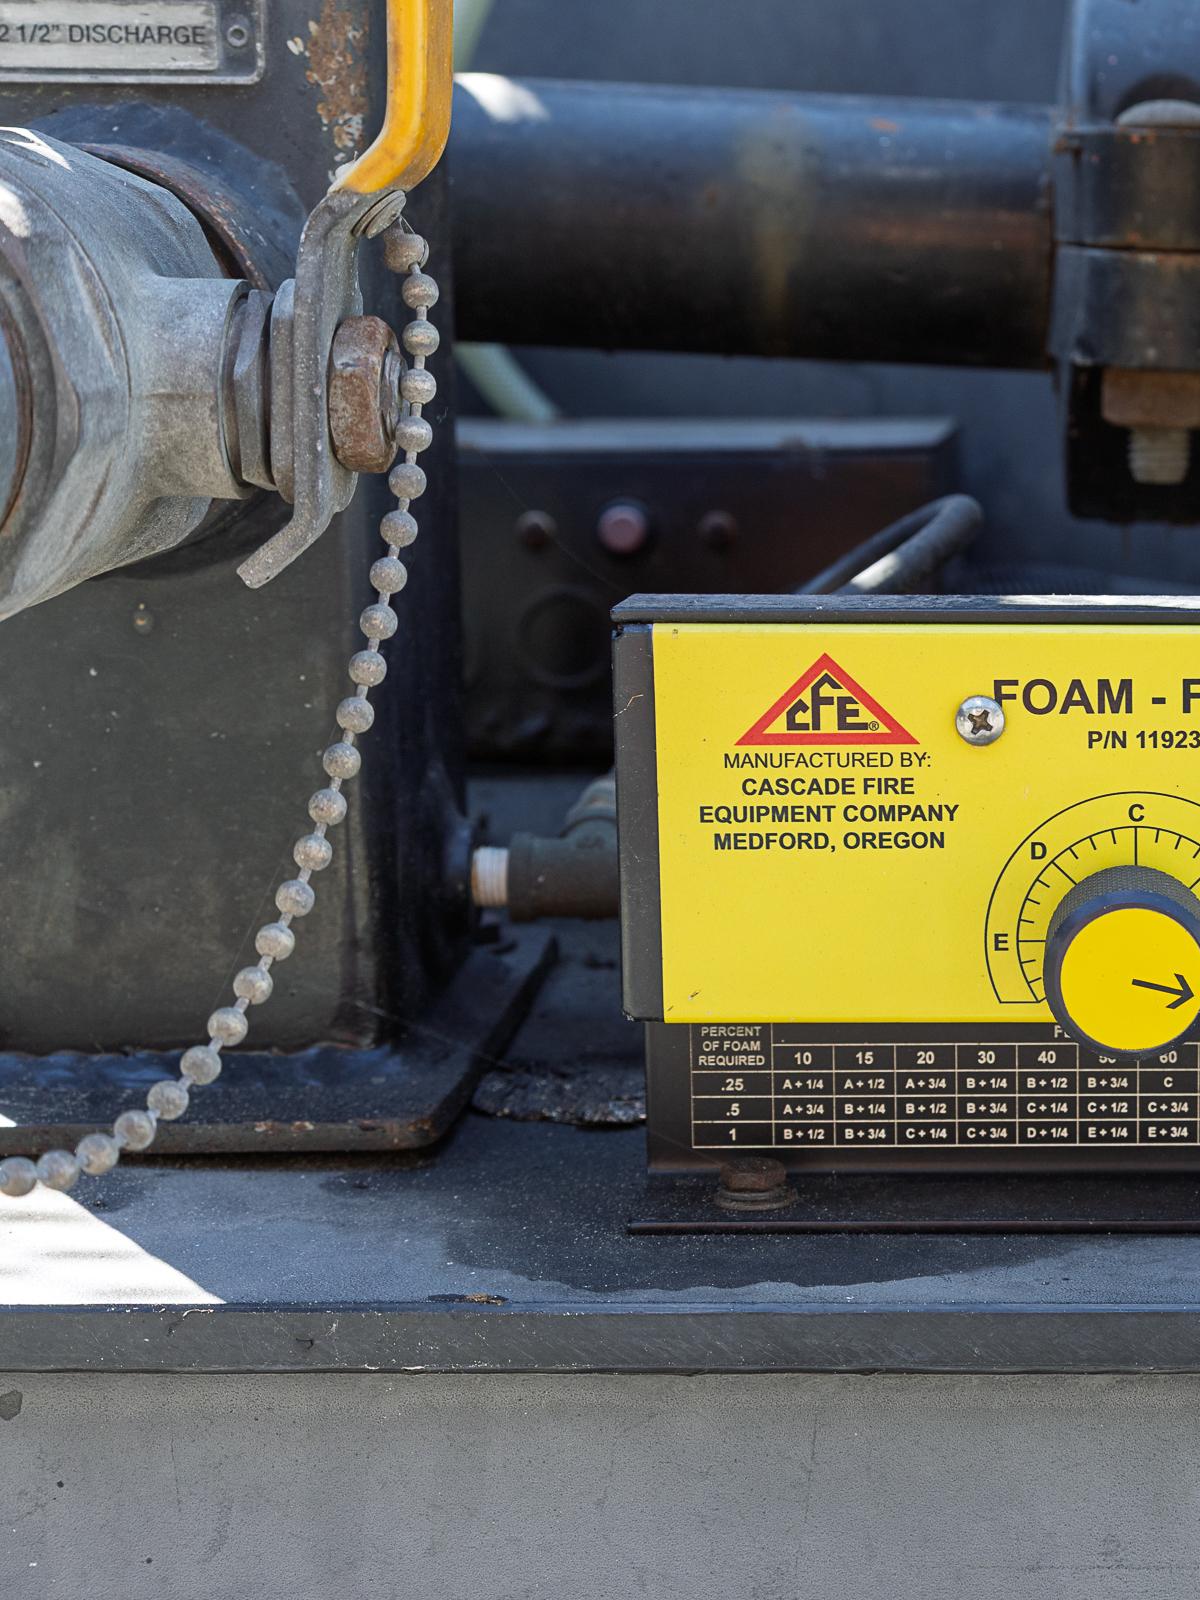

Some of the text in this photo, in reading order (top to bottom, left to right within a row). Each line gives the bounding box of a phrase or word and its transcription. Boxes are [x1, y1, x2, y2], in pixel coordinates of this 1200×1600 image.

[68, 24, 209, 45] DISCHARGE
[993, 678, 1133, 716] FOAM
[1087, 730, 1127, 750] P/N
[724, 751, 931, 769] MANUFACTURED BY:
[741, 777, 915, 796] CASCADE FIRE
[699, 804, 960, 824] EQUIPMENT COMPANY
[1128, 803, 1145, 823] C
[713, 831, 945, 853] MEDFORD, OREGON
[1030, 841, 1048, 860] D
[993, 933, 1010, 952] E
[701, 1026, 762, 1037] PERCENT
[702, 1040, 761, 1052] OF FOAM
[698, 1054, 765, 1066] REQUIRED
[794, 1051, 812, 1065] 10
[855, 1051, 874, 1065] 15
[916, 1050, 935, 1065] 20
[977, 1050, 996, 1065] 30
[1037, 1050, 1057, 1064] 40
[721, 1078, 744, 1091] .25
[782, 1079, 793, 1090] A
[806, 1079, 824, 1090] 1/4
[843, 1078, 854, 1090] A
[867, 1078, 885, 1090] 1/2
[905, 1078, 915, 1089] A
[928, 1078, 947, 1089] 3/4
[966, 1077, 976, 1089] B
[989, 1077, 1008, 1089] 1/4
[1026, 1077, 1037, 1089] B
[1050, 1077, 1068, 1089] 1/2
[1087, 1077, 1097, 1089] B
[1110, 1077, 1129, 1089] 3/4
[1163, 1076, 1173, 1088] C
[725, 1102, 740, 1117] .5
[783, 1103, 793, 1115] A
[806, 1103, 825, 1115] 3/4
[844, 1103, 854, 1115] B
[867, 1103, 886, 1114] 1/4
[905, 1103, 916, 1114] B
[929, 1102, 947, 1114] 1/2
[966, 1102, 976, 1114] B
[989, 1102, 1008, 1114] 3/4
[1026, 1102, 1037, 1114] C
[1050, 1102, 1069, 1113] 1/4
[1087, 1101, 1097, 1113] C
[1110, 1102, 1128, 1113] 1/2
[1147, 1101, 1158, 1113] C
[1170, 1101, 1189, 1113] 3/4
[728, 1128, 736, 1141] 1
[783, 1128, 793, 1140] B
[807, 1128, 825, 1140] 1/2
[844, 1128, 855, 1140] B
[867, 1128, 887, 1140] 3/4
[905, 1127, 916, 1139] C
[929, 1128, 948, 1139] 1/4
[966, 1127, 976, 1139] C
[989, 1127, 1008, 1139] 3/4
[1027, 1127, 1037, 1138] D
[1050, 1127, 1069, 1138] 1/4
[1088, 1126, 1097, 1138] E
[1110, 1127, 1128, 1138] 1/4
[1147, 1126, 1157, 1138] E
[1170, 1126, 1189, 1138] 3/4
